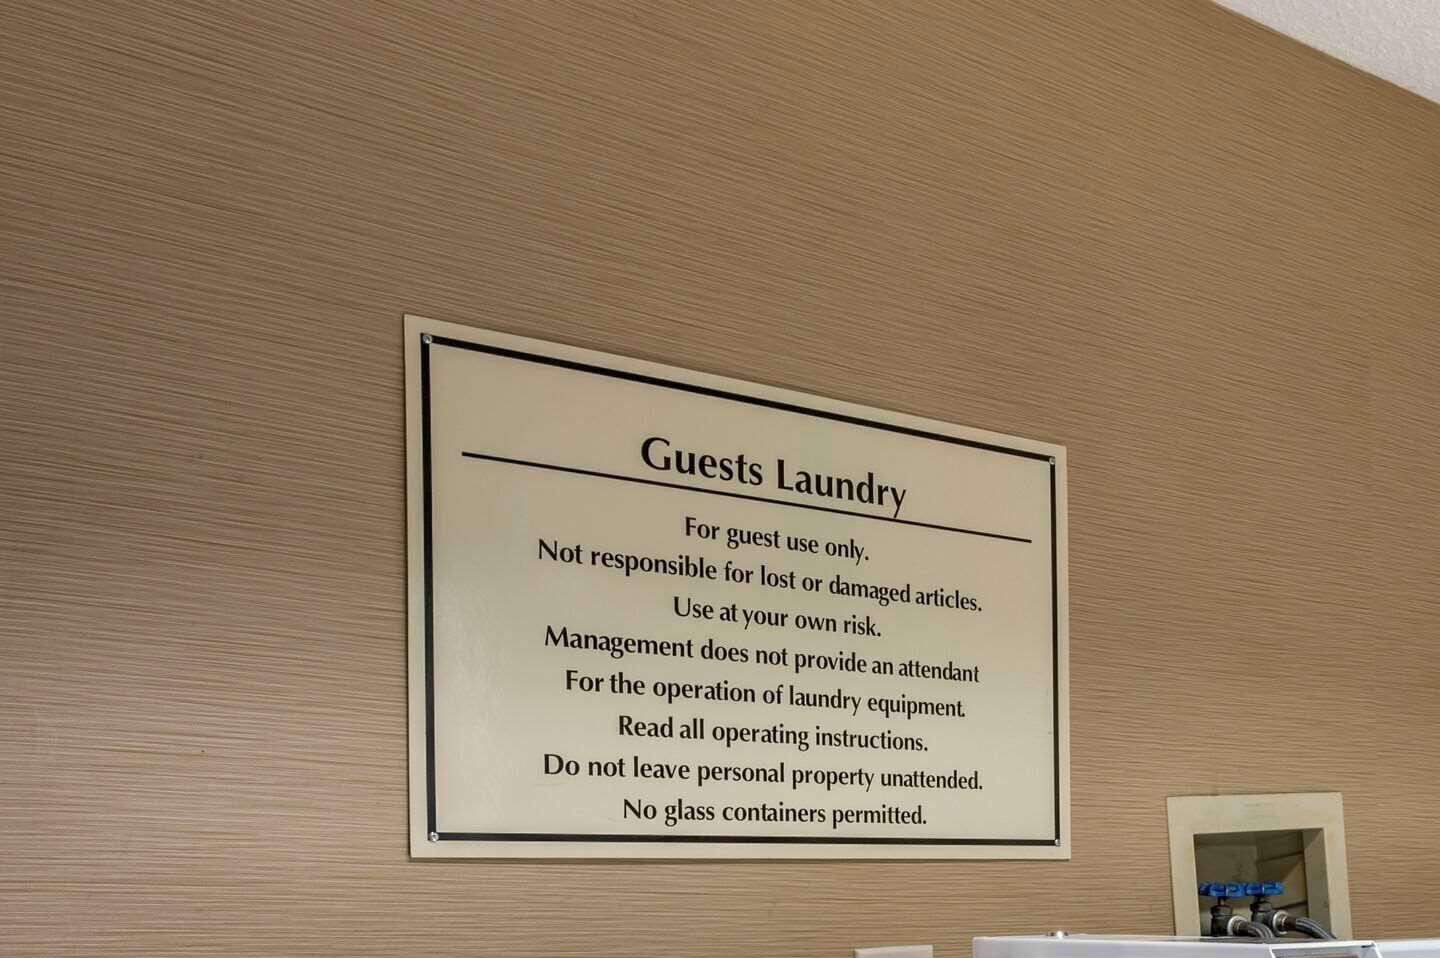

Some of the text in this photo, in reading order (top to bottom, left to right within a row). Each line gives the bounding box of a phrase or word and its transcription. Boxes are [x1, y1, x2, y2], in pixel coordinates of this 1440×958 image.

[640, 436, 908, 519] Guests Laundry
[684, 515, 870, 567] For guest use only.
[538, 538, 983, 612] Not responsible for lost or damaged articles.
[673, 595, 882, 638] Use at your own risk.
[544, 624, 980, 683] Management does not provide an attendant
[565, 669, 966, 721] For the operation of laundry equipment.
[618, 715, 928, 752] Read all operating instructions.
[543, 753, 983, 793] Do not leave personal property unattended.
[623, 798, 927, 830] No glass containers permitted.
